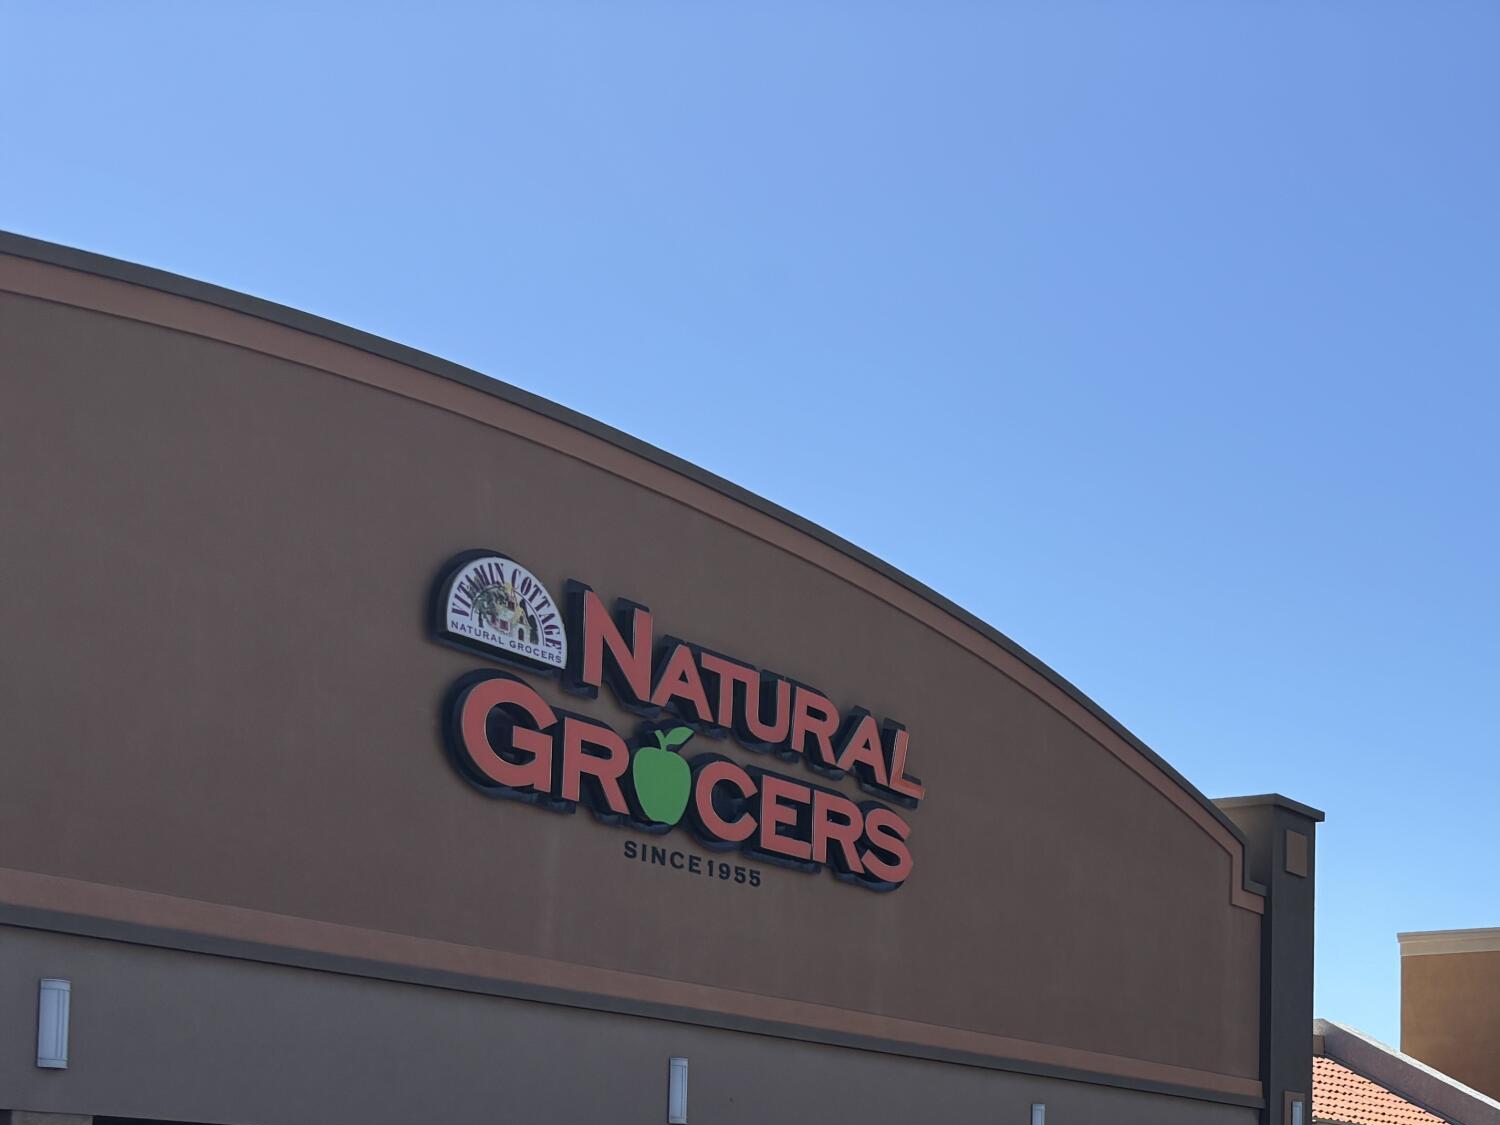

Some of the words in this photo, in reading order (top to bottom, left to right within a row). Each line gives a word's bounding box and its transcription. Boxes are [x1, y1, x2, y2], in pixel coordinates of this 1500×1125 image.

[451, 562, 505, 617] VITAMIN
[511, 568, 563, 651] COTTAGE
[451, 620, 505, 645] NATURAL
[509, 640, 562, 664] GROCERS
[583, 590, 926, 802] NATURAL
